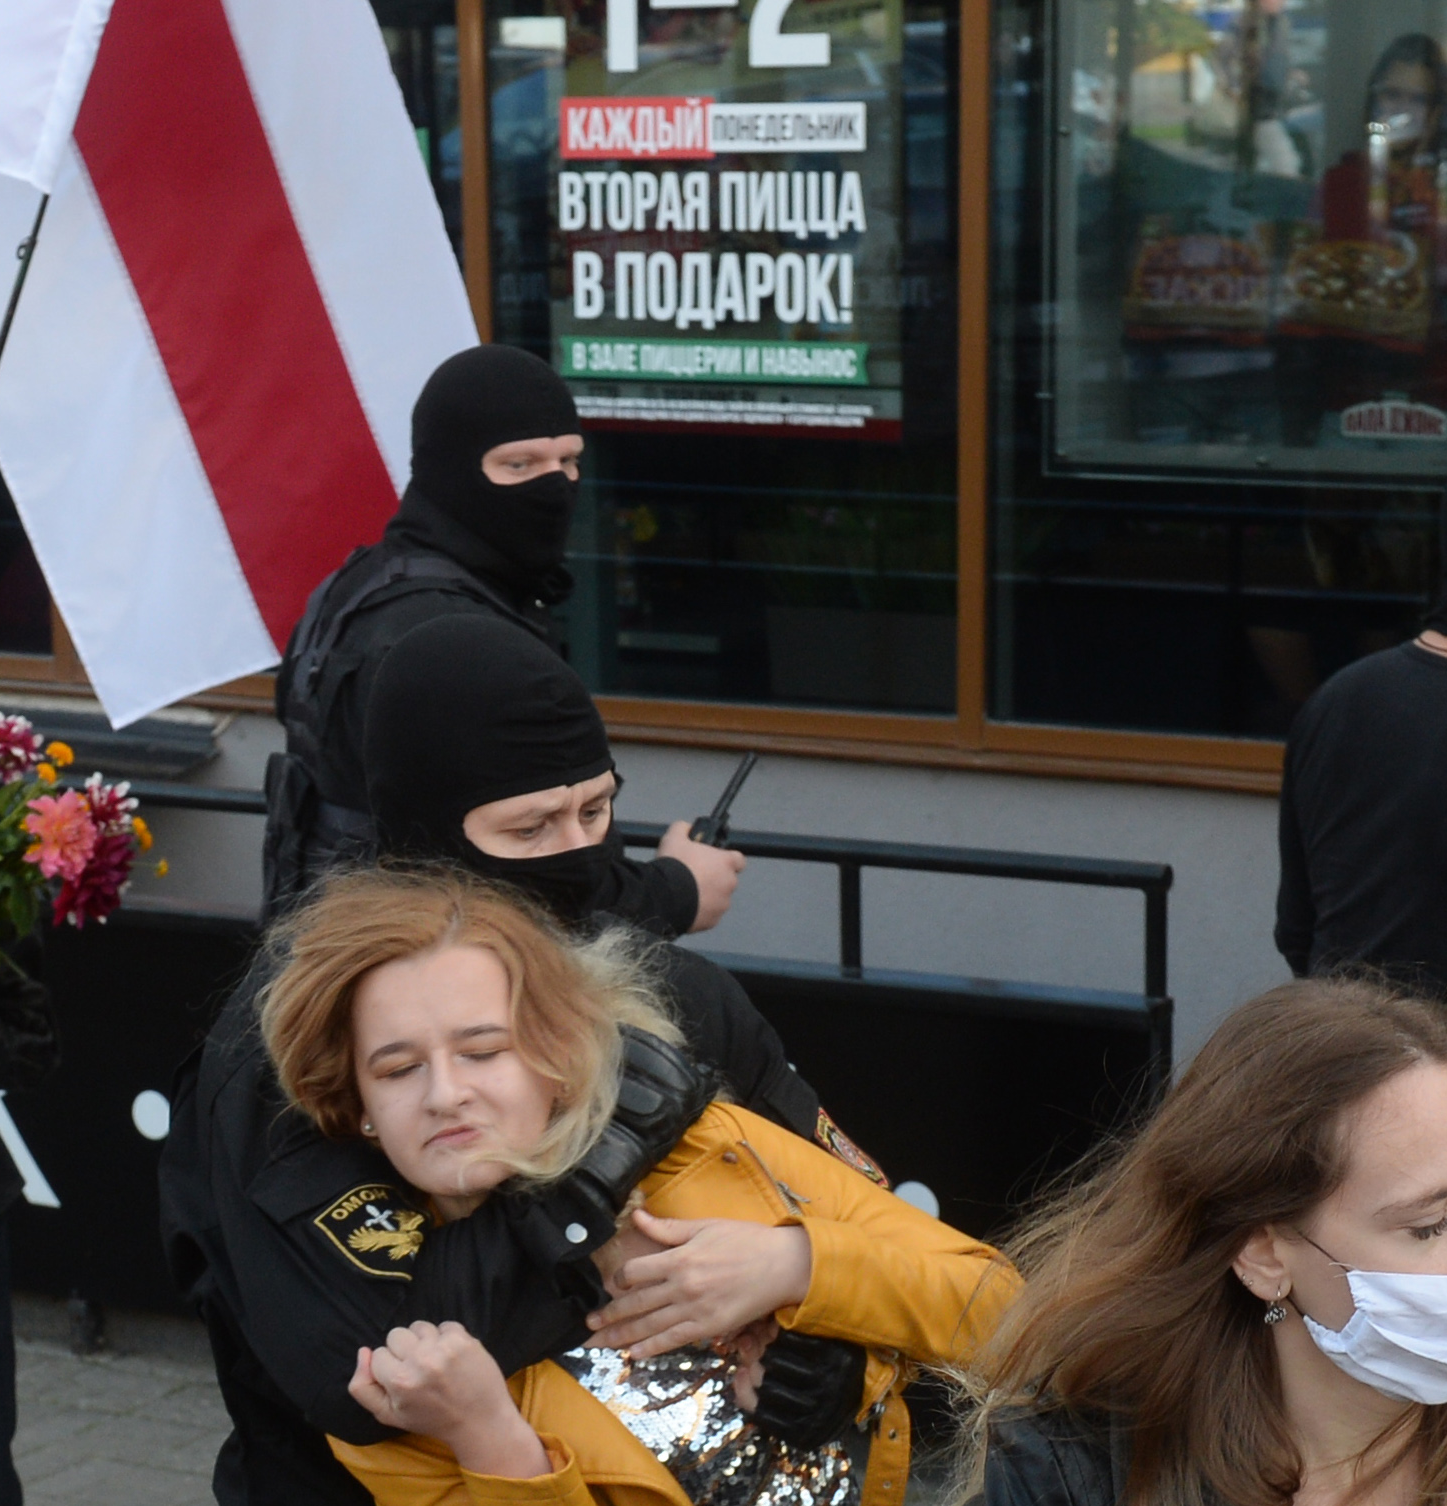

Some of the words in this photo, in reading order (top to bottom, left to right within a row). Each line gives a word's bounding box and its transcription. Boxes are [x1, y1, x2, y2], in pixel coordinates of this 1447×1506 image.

[566, 98, 704, 155] КАЖДЫЙ
[713, 114, 860, 143] ПОНЕДЕЛЬНИК
[558, 170, 711, 232] ВТОРАЯ
[719, 170, 867, 239] ПИЦЦА
[572, 250, 604, 320] В
[614, 251, 853, 330] ПОДАРОК!
[331, 1189, 389, 1220] ОМОН
